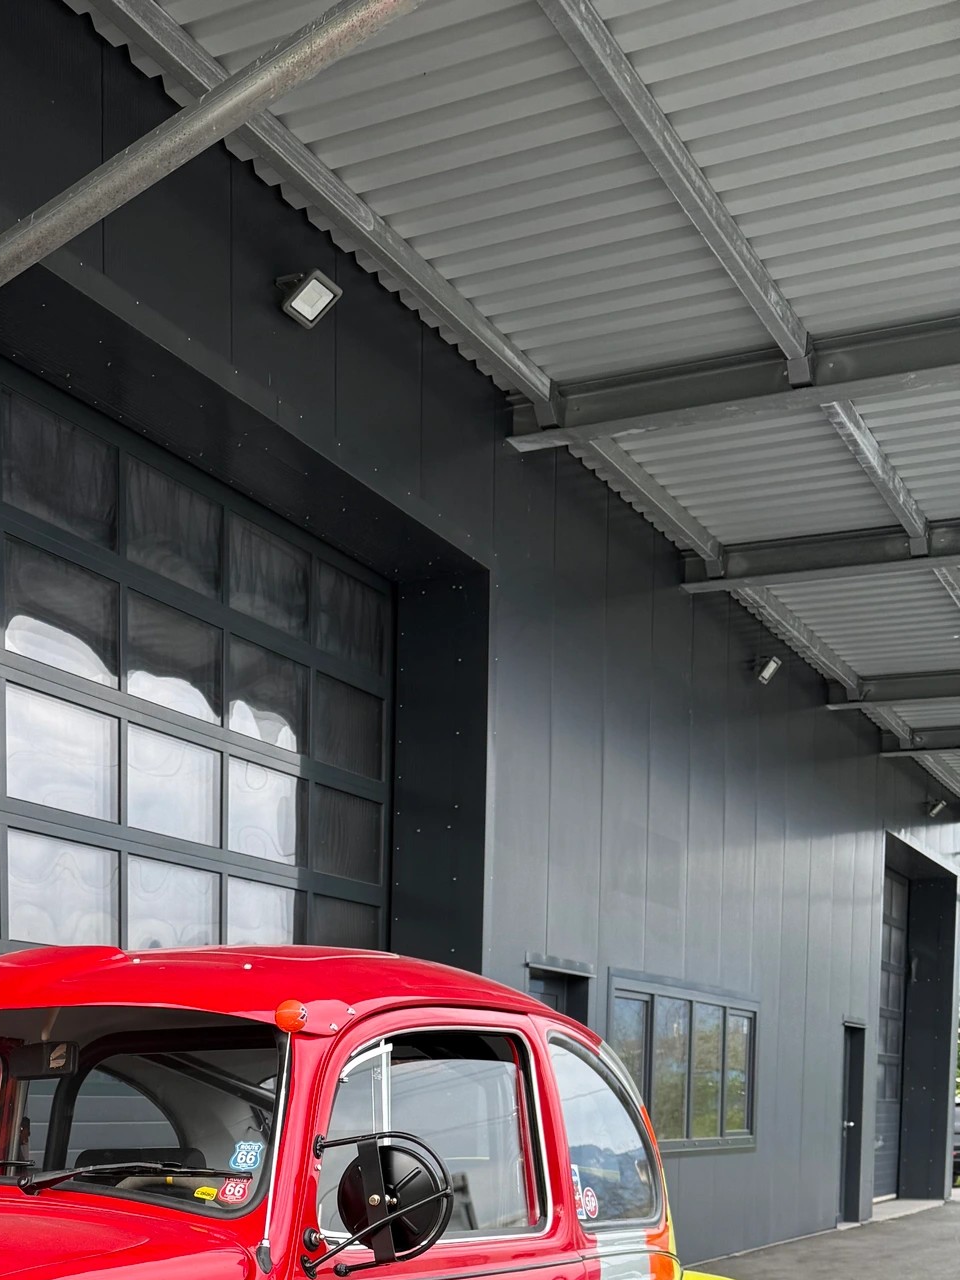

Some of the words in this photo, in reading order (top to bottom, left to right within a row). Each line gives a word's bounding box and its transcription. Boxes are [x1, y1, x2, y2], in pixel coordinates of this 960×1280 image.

[237, 1151, 256, 1164] 66
[225, 1183, 245, 1196] 66
[585, 1191, 596, 1212] STP
